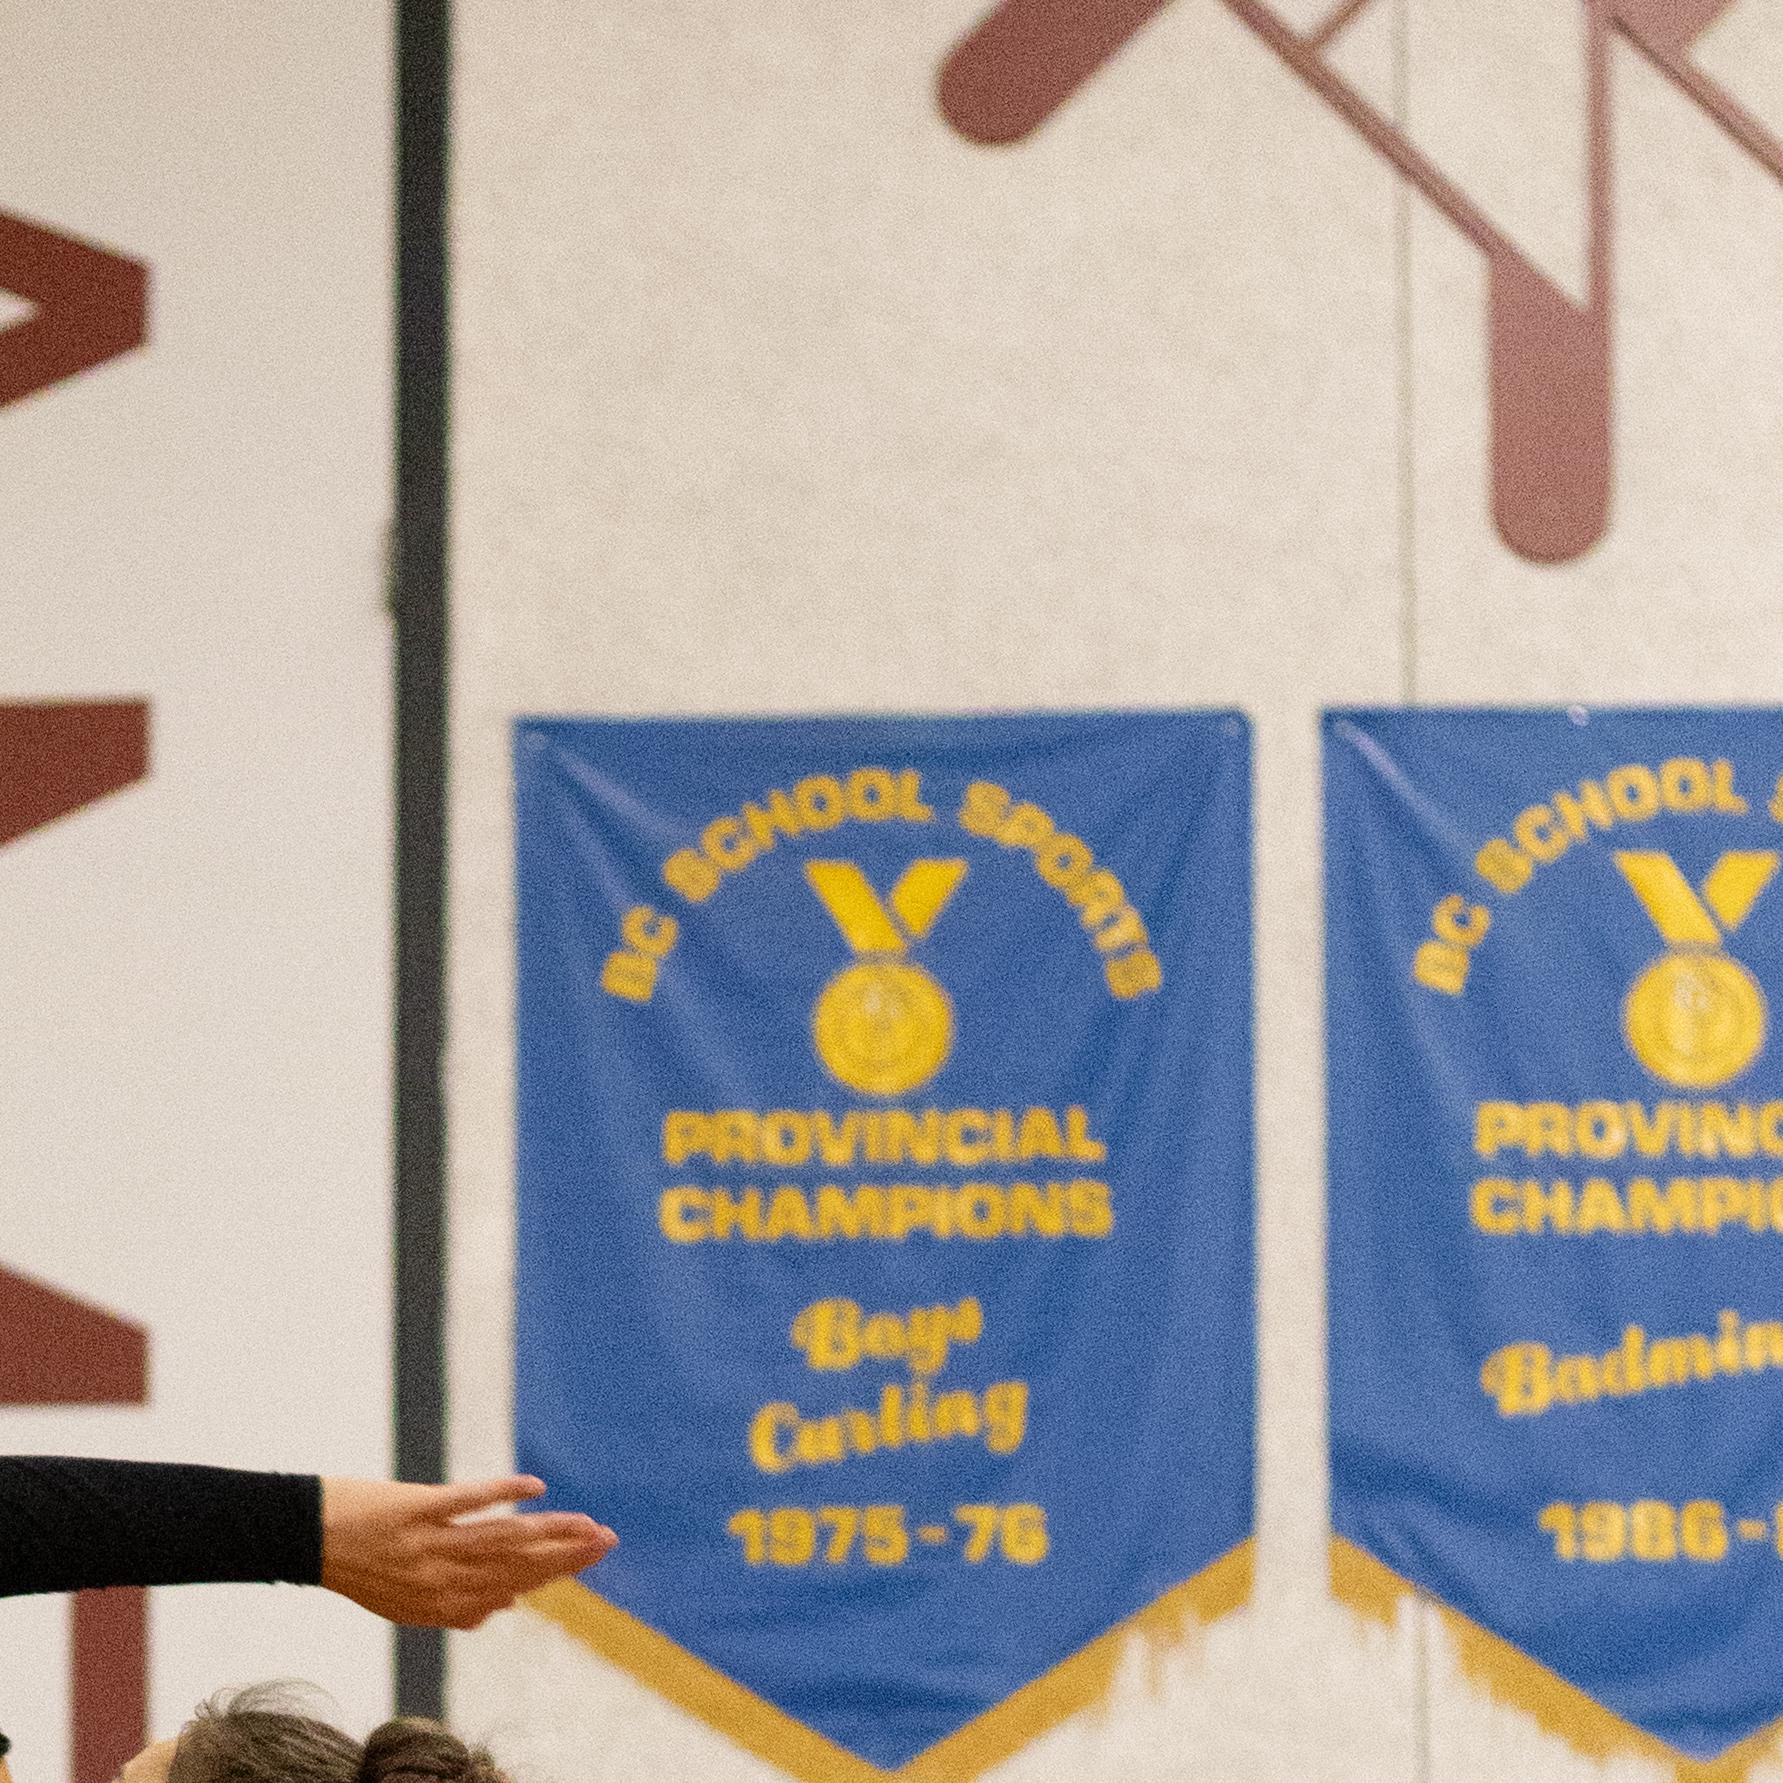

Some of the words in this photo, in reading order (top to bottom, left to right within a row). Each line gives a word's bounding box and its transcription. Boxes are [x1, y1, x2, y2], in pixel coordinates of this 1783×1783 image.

[600, 905, 680, 1001] BC
[662, 767, 936, 903] SCHOOL
[959, 780, 1163, 1000] SPORTS
[1413, 893, 1491, 996] BC
[1474, 756, 1749, 893] SCHOOL
[661, 1105, 1107, 1166] PROVINCIAL
[658, 1179, 1115, 1242] CHAMPIONS
[791, 1296, 983, 1372] Boys
[750, 1375, 1029, 1473] Curling
[1537, 1499, 1783, 1562] 1986-
